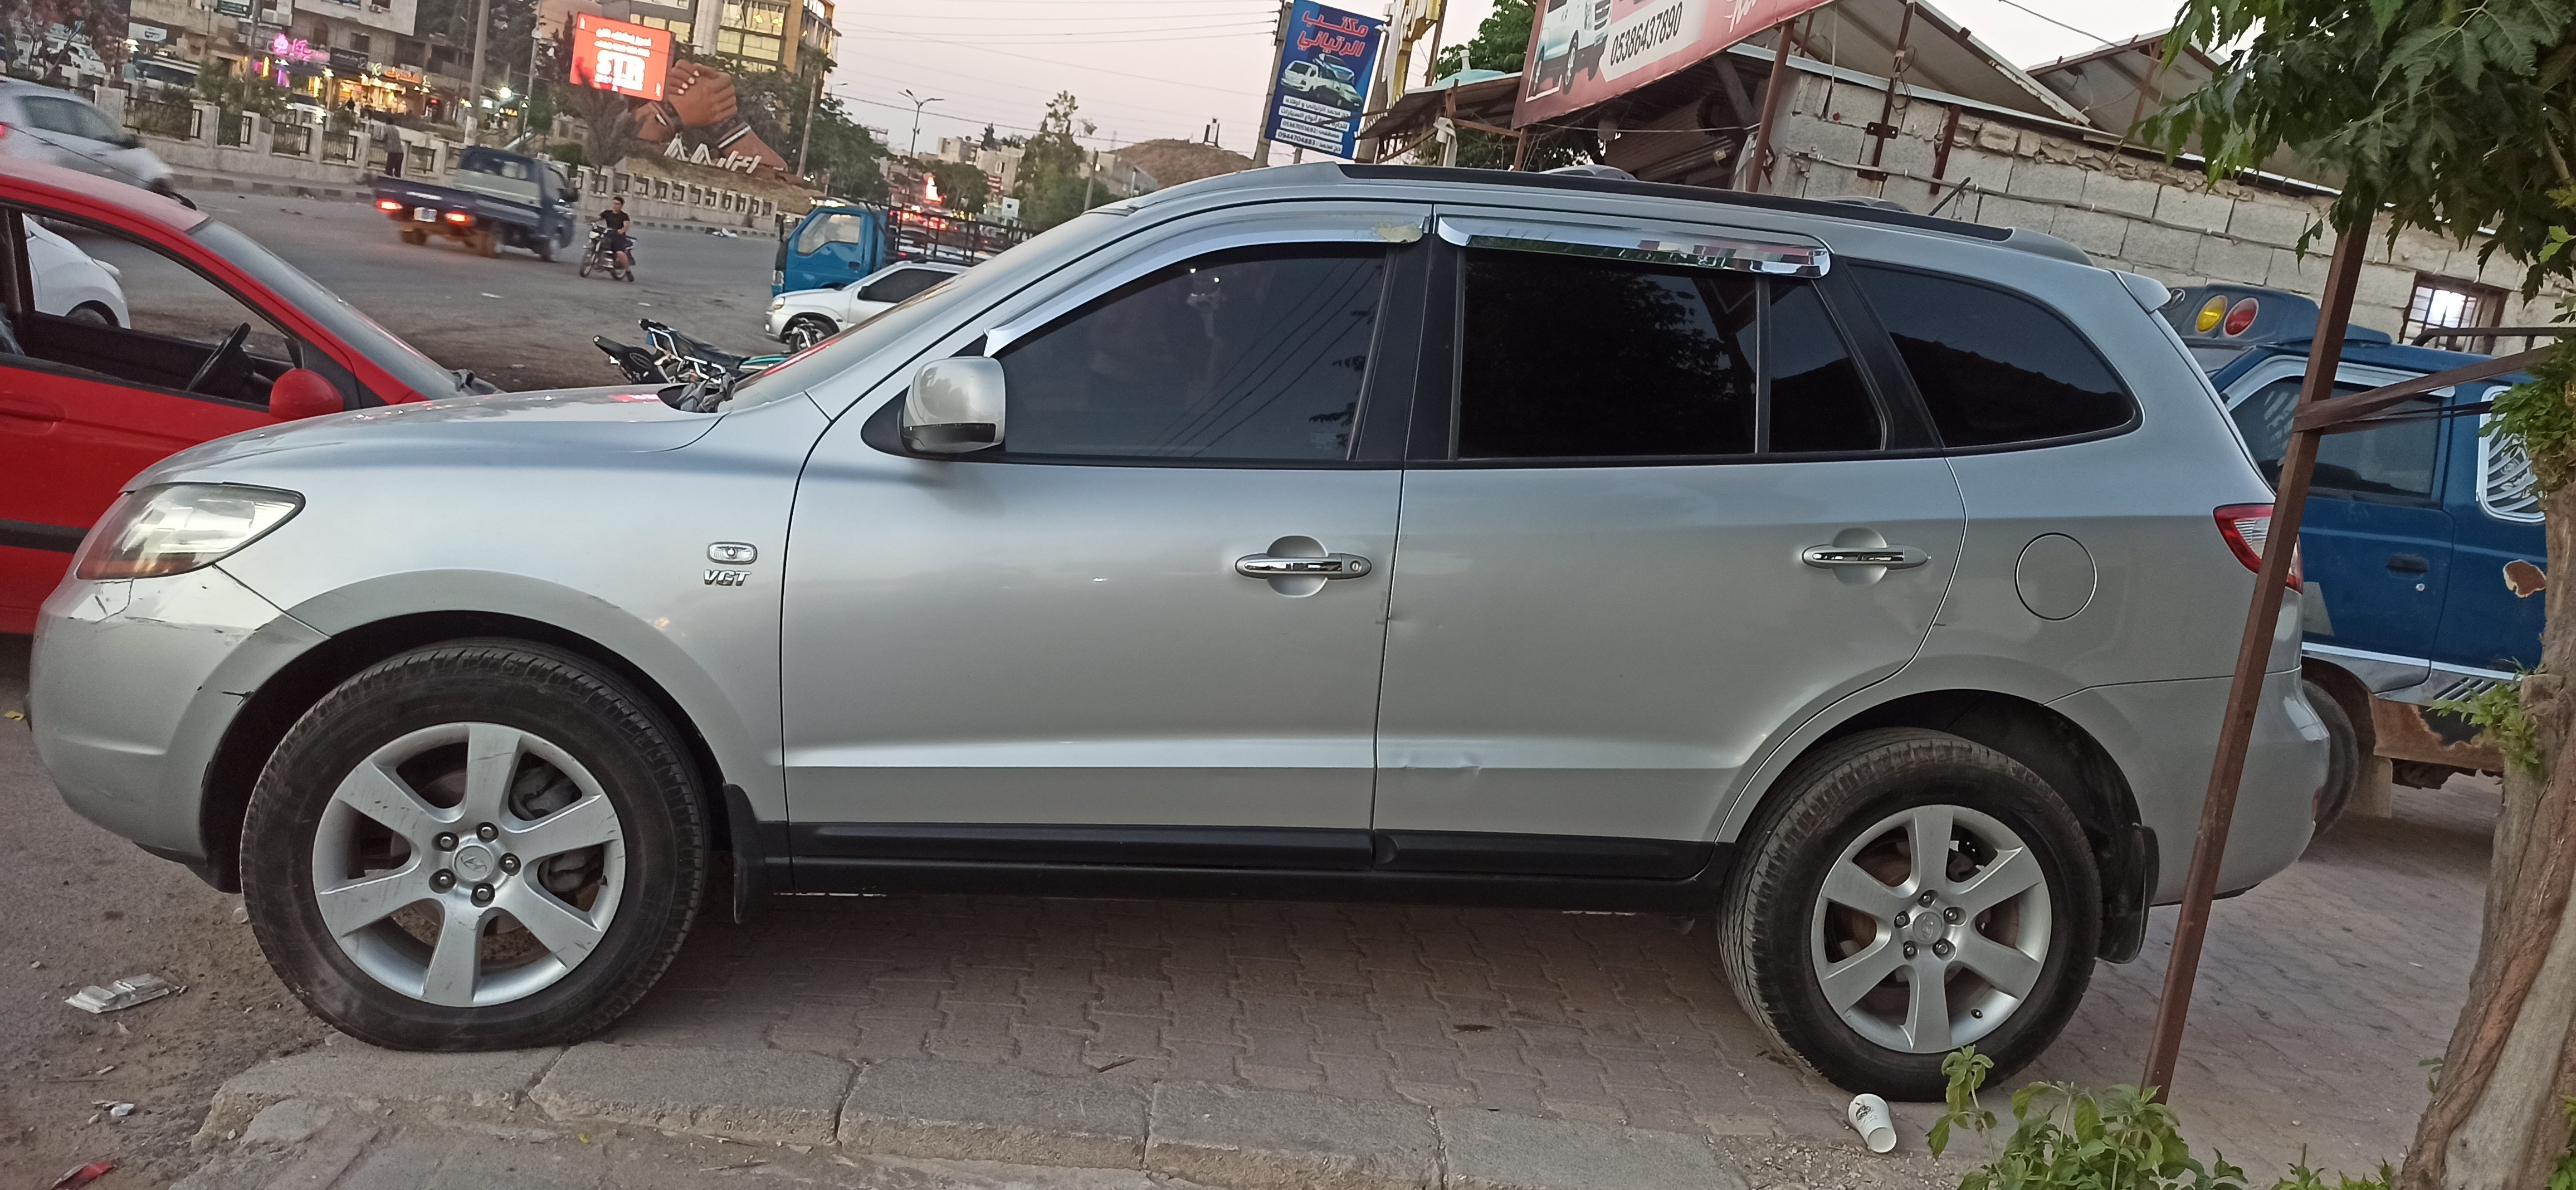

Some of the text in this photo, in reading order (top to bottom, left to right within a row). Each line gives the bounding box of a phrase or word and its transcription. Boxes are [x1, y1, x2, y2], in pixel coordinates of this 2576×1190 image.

[1302, 11, 1369, 37] مكتب
[1610, 1, 1682, 66] 05386437890
[1297, 30, 1366, 57] الرتياني
[703, 569, 752, 587] VGT
